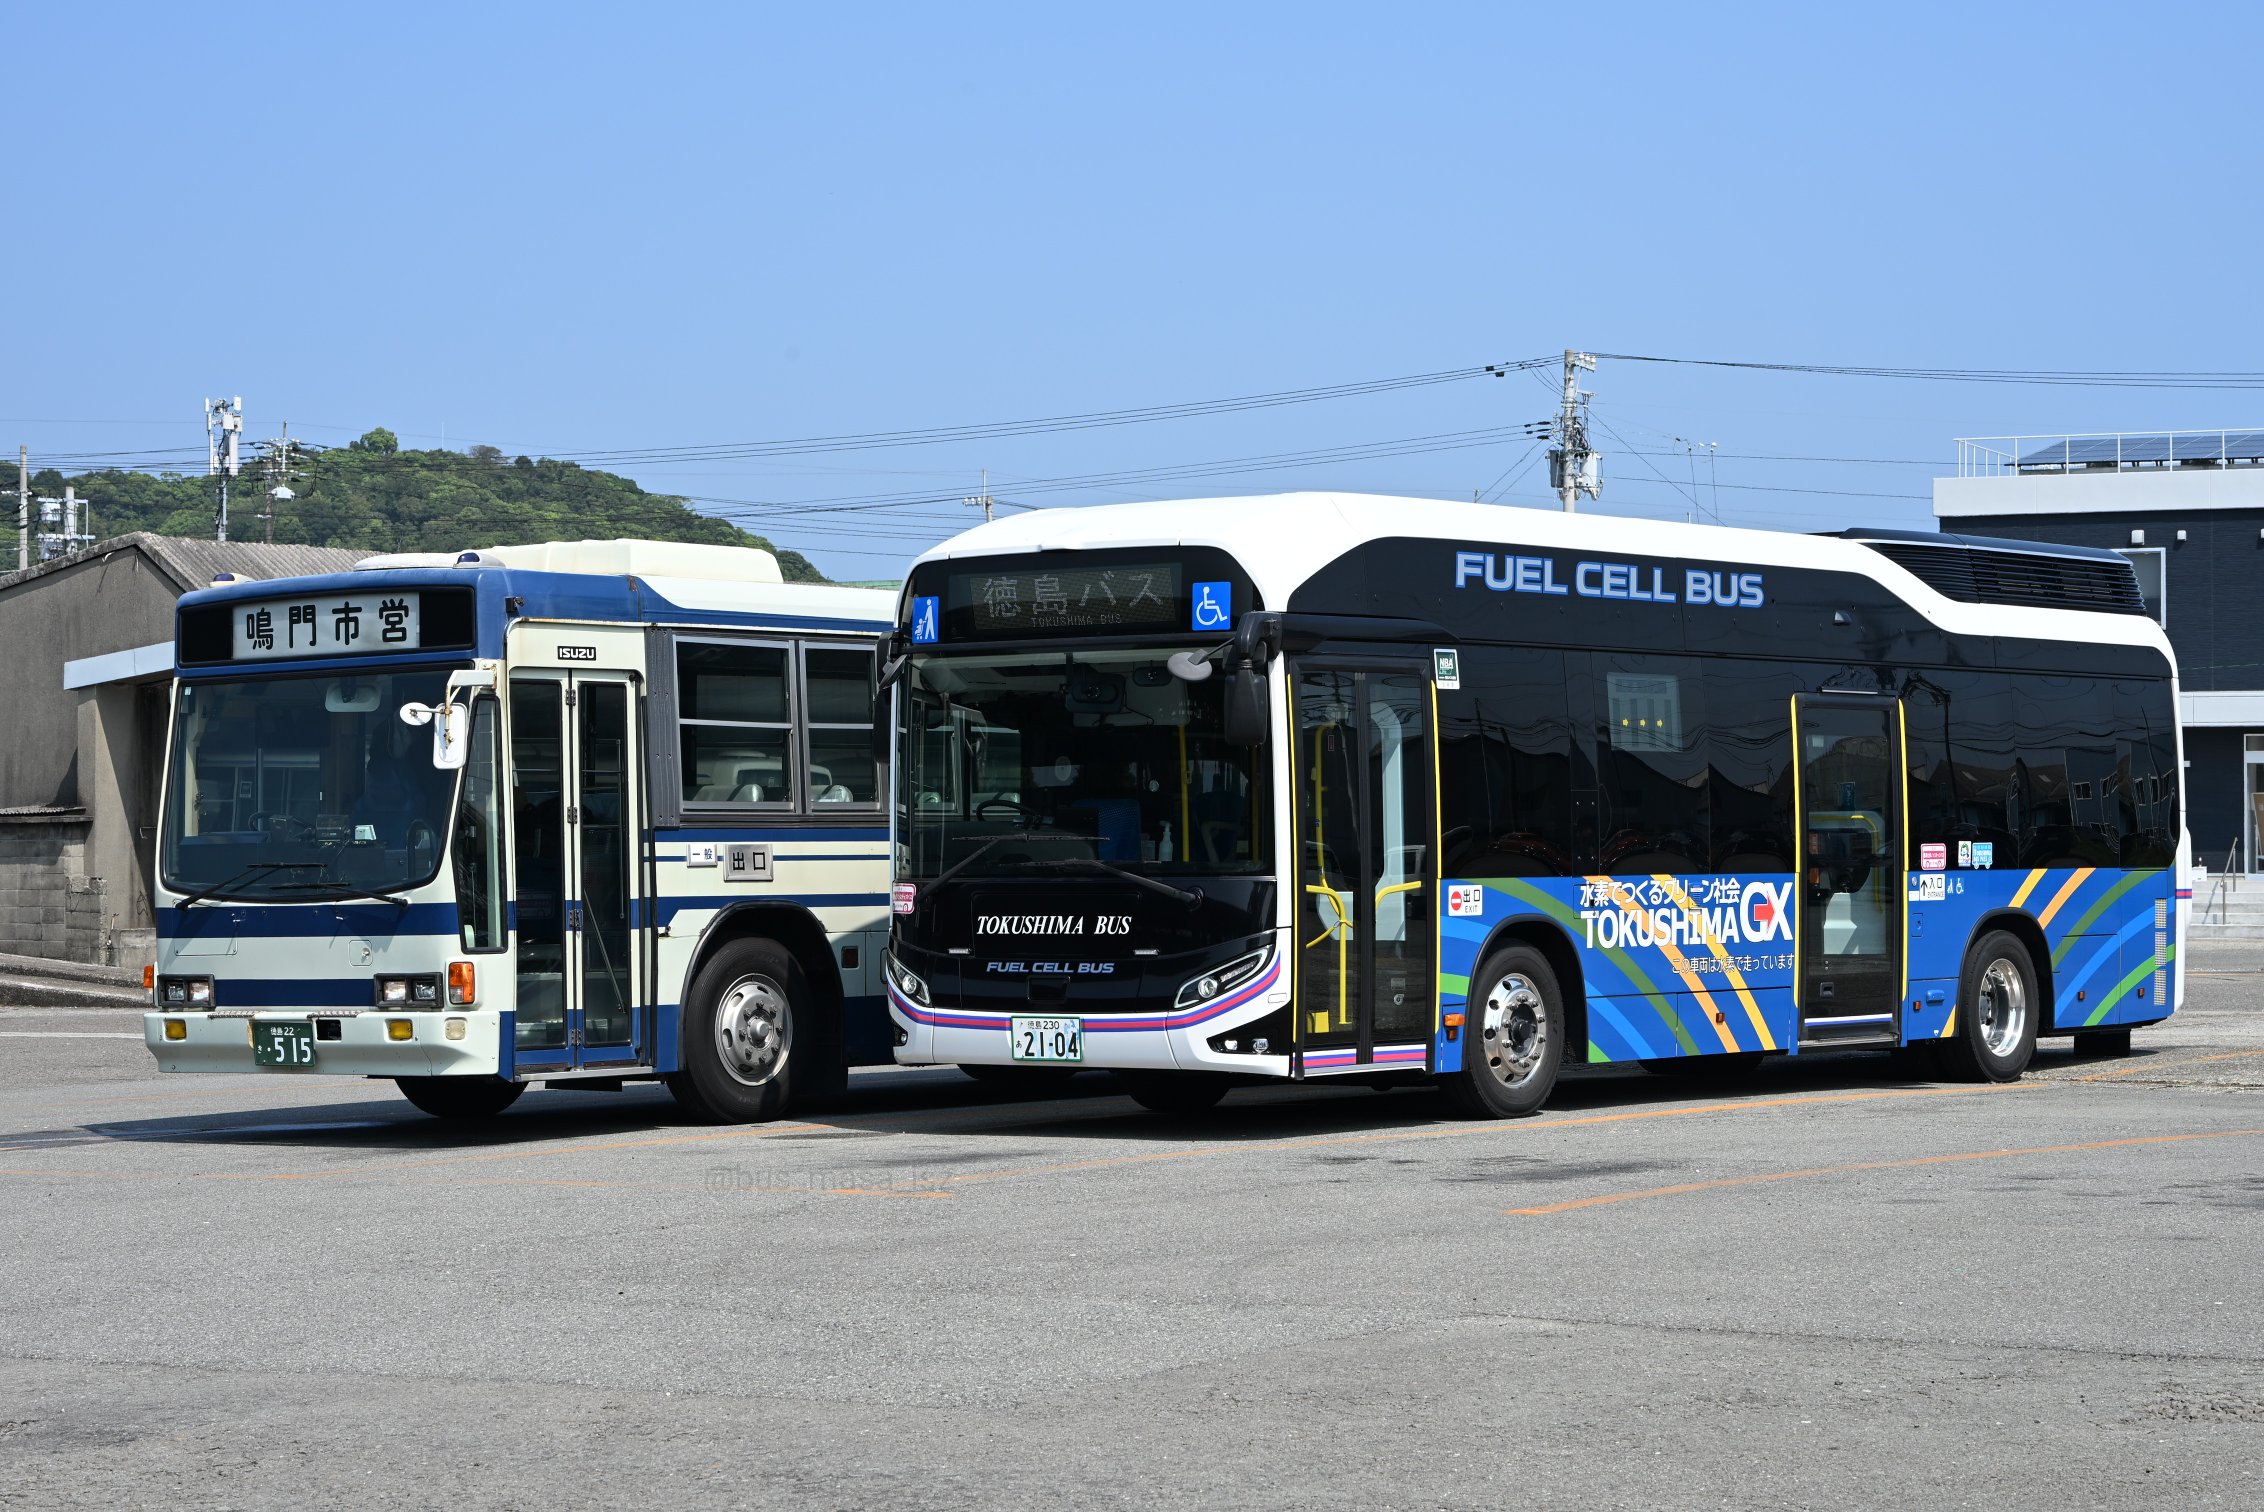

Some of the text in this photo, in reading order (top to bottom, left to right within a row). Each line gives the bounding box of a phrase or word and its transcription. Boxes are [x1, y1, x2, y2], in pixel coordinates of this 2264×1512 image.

[1455, 551, 1764, 608] FUEL CELL BUS
[982, 571, 1163, 618] 徳島バス
[246, 598, 409, 650] 鳴門市営
[1031, 613, 1123, 628] TOKUSHIMA BUS
[559, 647, 595, 659] ISUZU
[1439, 657, 1454, 669] NBA
[692, 848, 713, 860] 一般
[732, 851, 766, 871] 出口
[1580, 877, 1741, 907] 水素でつくるグリーン社会
[1928, 877, 1943, 889] 入口
[1463, 889, 1481, 902] 出口
[1464, 905, 1479, 913] EXIT
[1580, 881, 1794, 949] TOKUSHIMA GX
[976, 915, 1132, 935] TOKUSHIMA BUS
[986, 961, 1115, 974] FUEL CELL BUS
[1672, 954, 1795, 975] この車両は水素で走っています
[1023, 1031, 1078, 1058] 21-04
